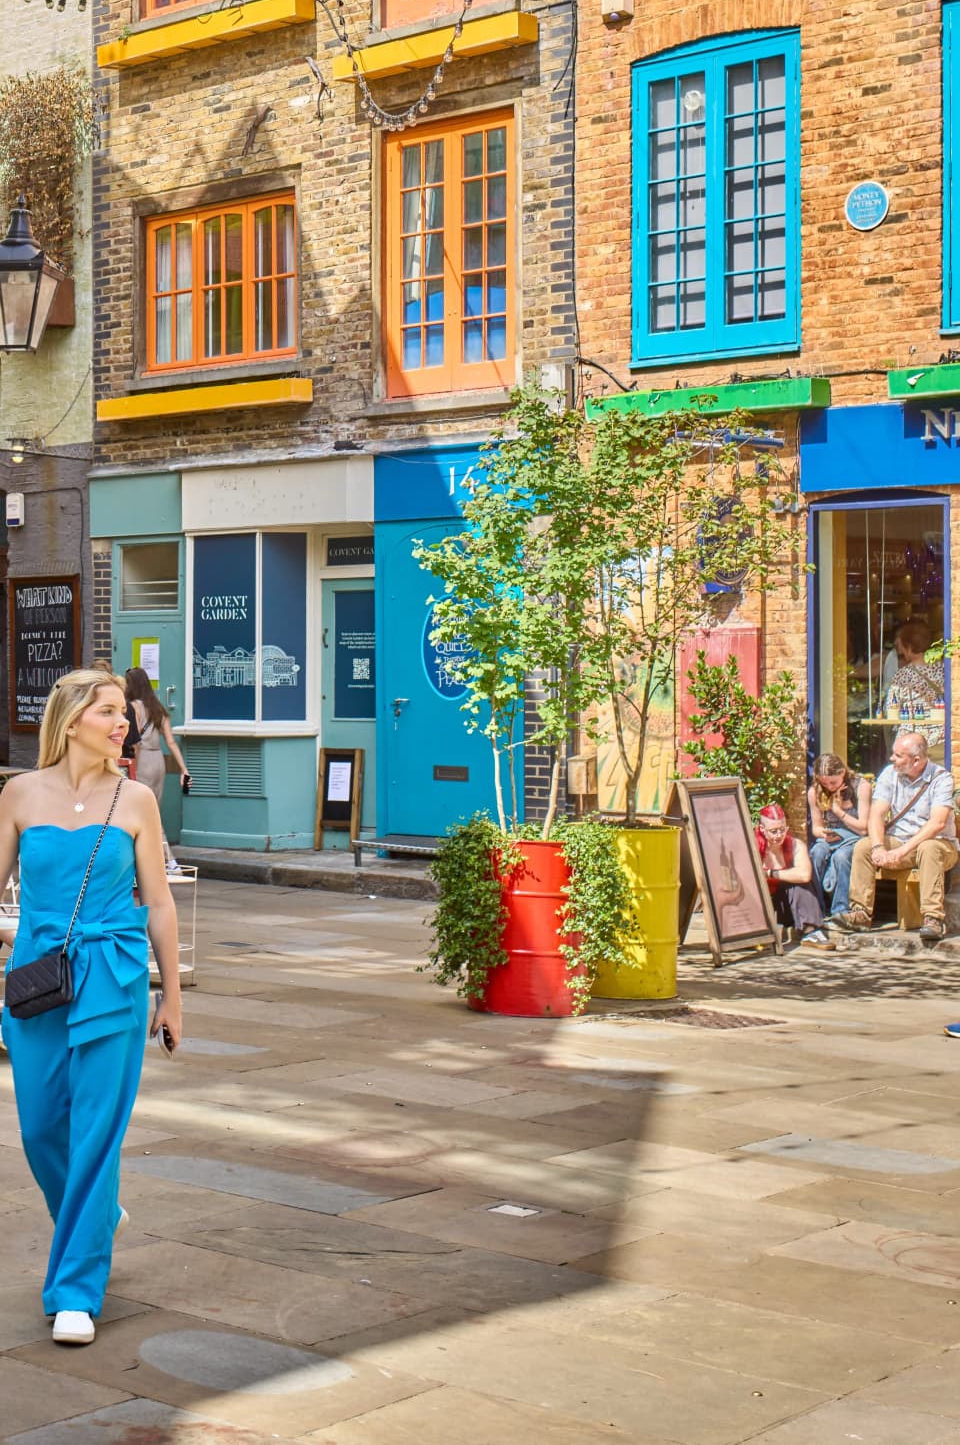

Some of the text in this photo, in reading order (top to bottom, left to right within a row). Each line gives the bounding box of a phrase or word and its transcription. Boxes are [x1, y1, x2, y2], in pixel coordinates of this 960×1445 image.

[449, 465, 480, 496] 14
[16, 587, 47, 609] WHAT
[201, 595, 248, 608] COVENT
[201, 608, 248, 620] GARDEN
[28, 640, 63, 663] PIZZA?
